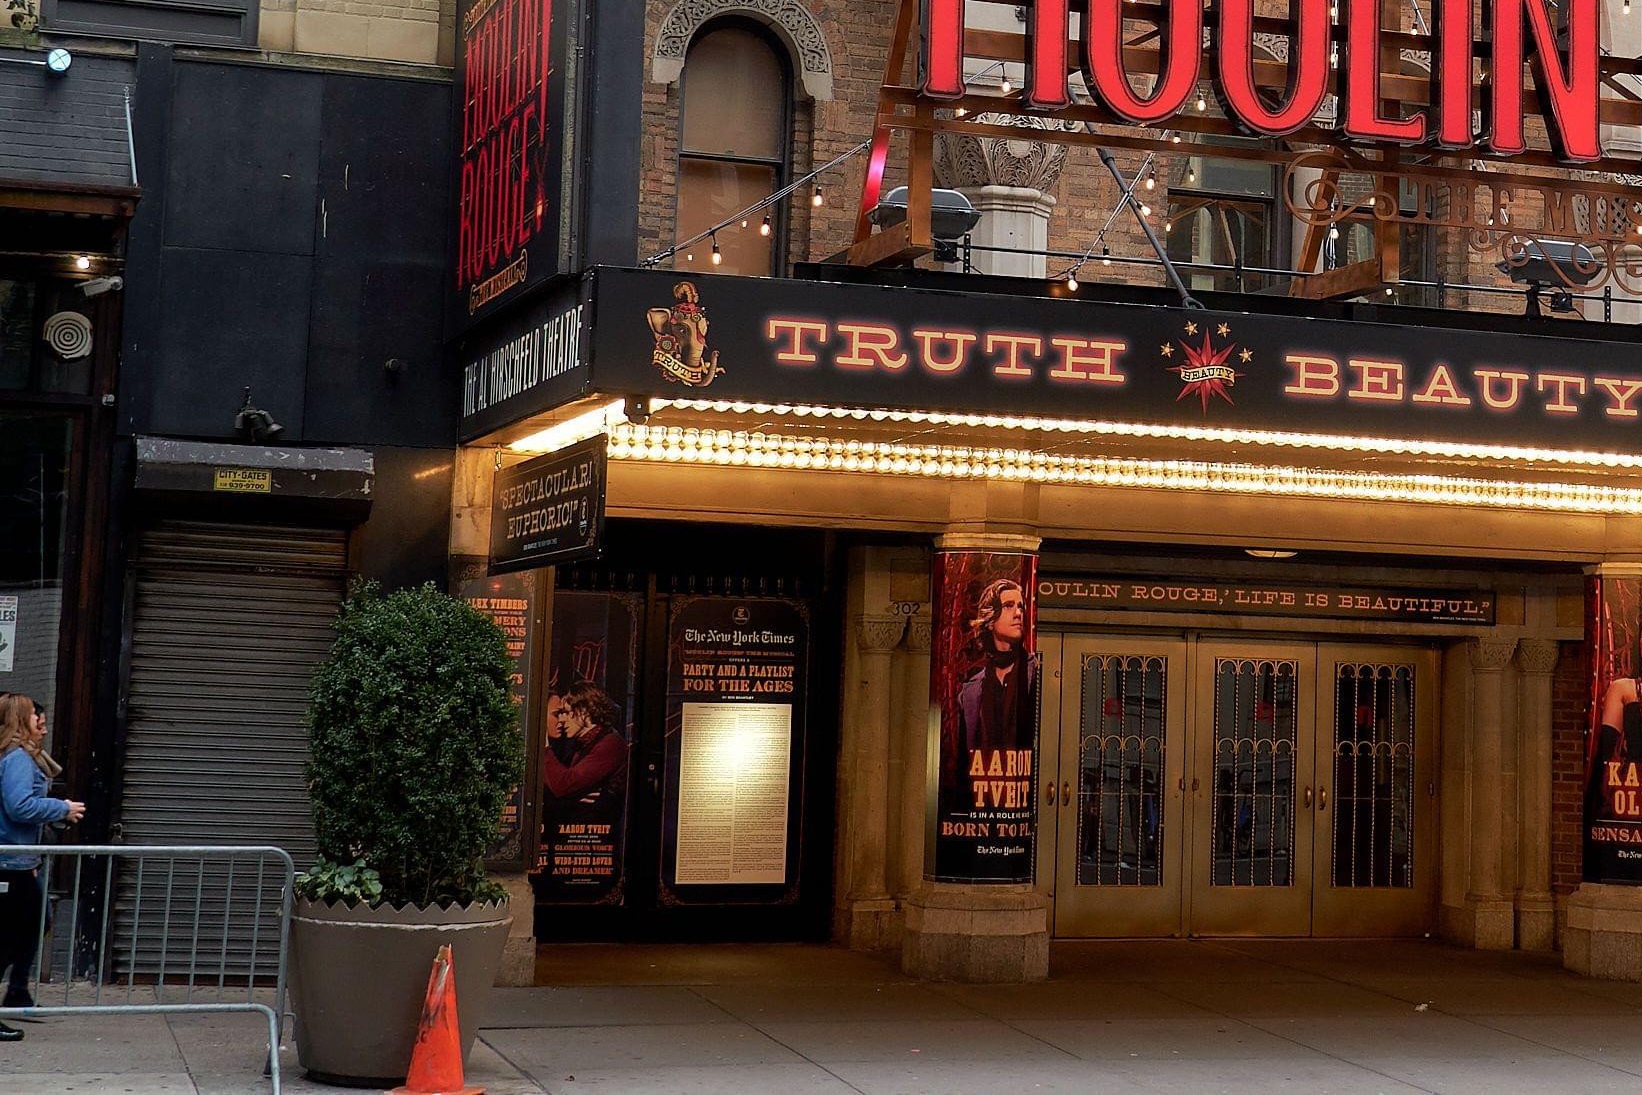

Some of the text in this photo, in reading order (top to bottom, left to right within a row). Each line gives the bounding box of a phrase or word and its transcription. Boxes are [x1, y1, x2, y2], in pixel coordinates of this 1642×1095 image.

[1404, 176, 1517, 228] THE
[766, 315, 1127, 385] TRUTH
[463, 304, 583, 418] THE AL HIRSCHFELD THEATRE
[654, 350, 702, 380] TRUTH
[1182, 366, 1234, 381] BEAUTY
[1037, 581, 1121, 599] OULIN
[1235, 589, 1296, 606] LIFE
[1305, 593, 1329, 607] IS
[892, 601, 922, 616] 302
[685, 628, 795, 646] The New York Times
[683, 663, 795, 678] PARTY AND A PLAYLIST
[683, 678, 794, 693] FOR THE AGES
[973, 781, 1030, 809] TVEIT
[969, 811, 977, 819] IS
[942, 821, 990, 837] BORN
[996, 822, 1017, 837] TO
[1618, 850, 1629, 859] The
[1629, 850, 1642, 859] New
[552, 867, 571, 875] AND
